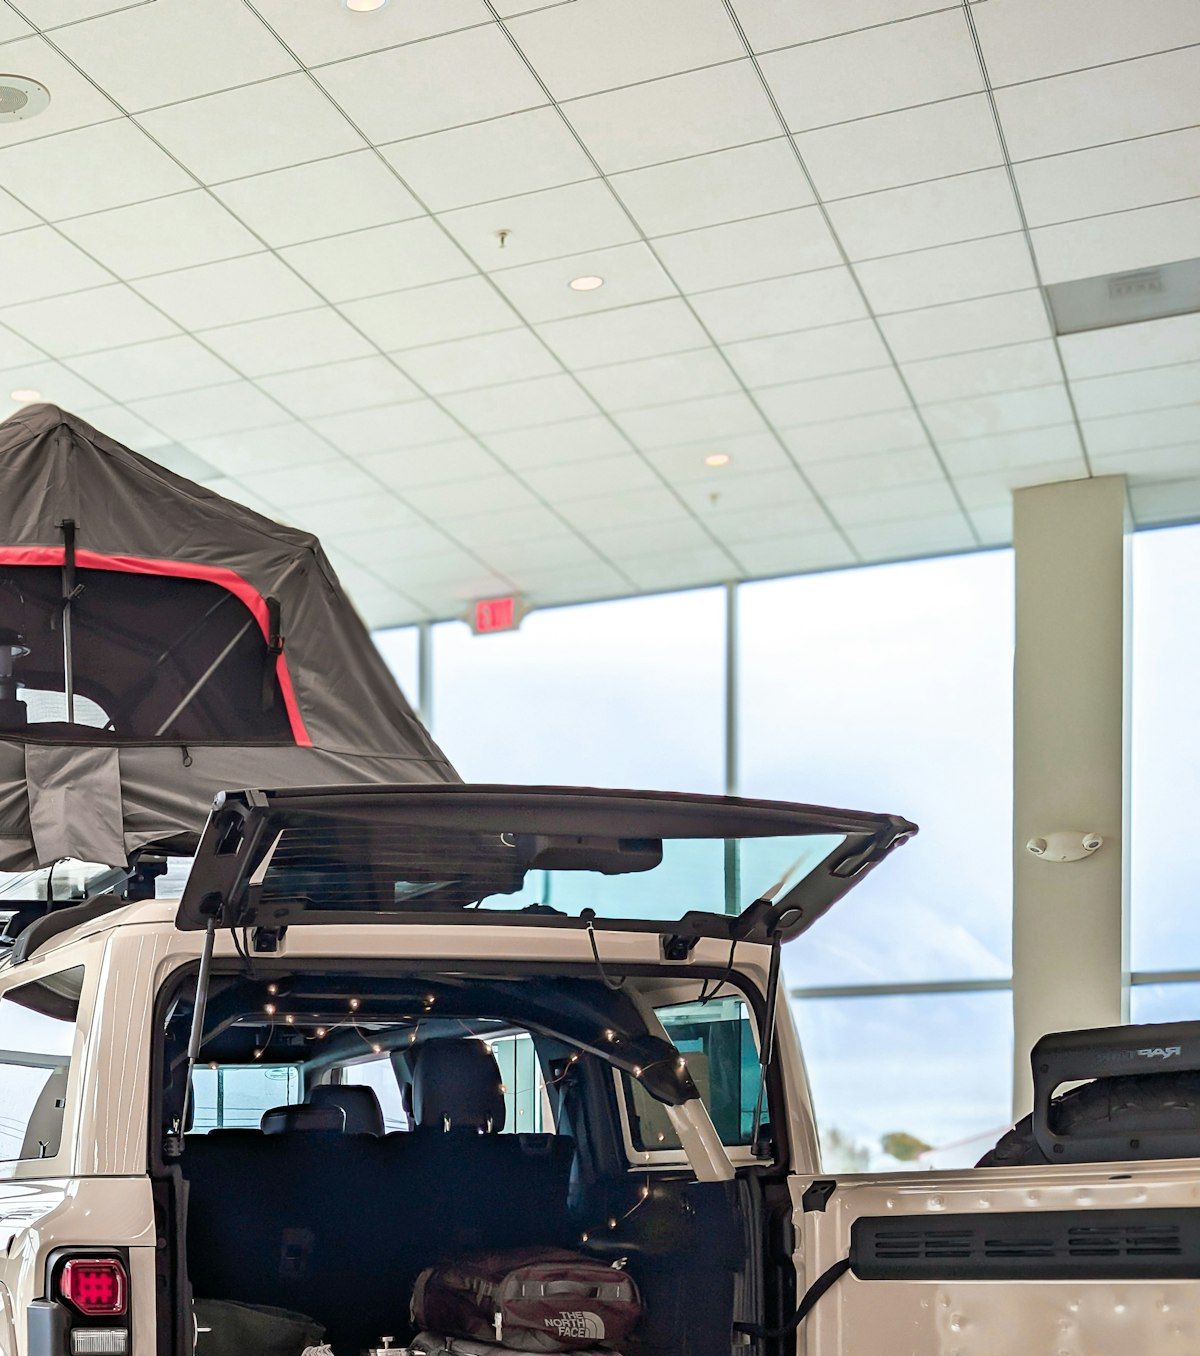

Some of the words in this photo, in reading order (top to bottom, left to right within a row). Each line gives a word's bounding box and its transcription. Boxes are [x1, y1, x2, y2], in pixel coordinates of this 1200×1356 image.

[558, 1311, 584, 1320] THE
[544, 1318, 586, 1328] NORTH
[558, 1327, 585, 1338] FACE
